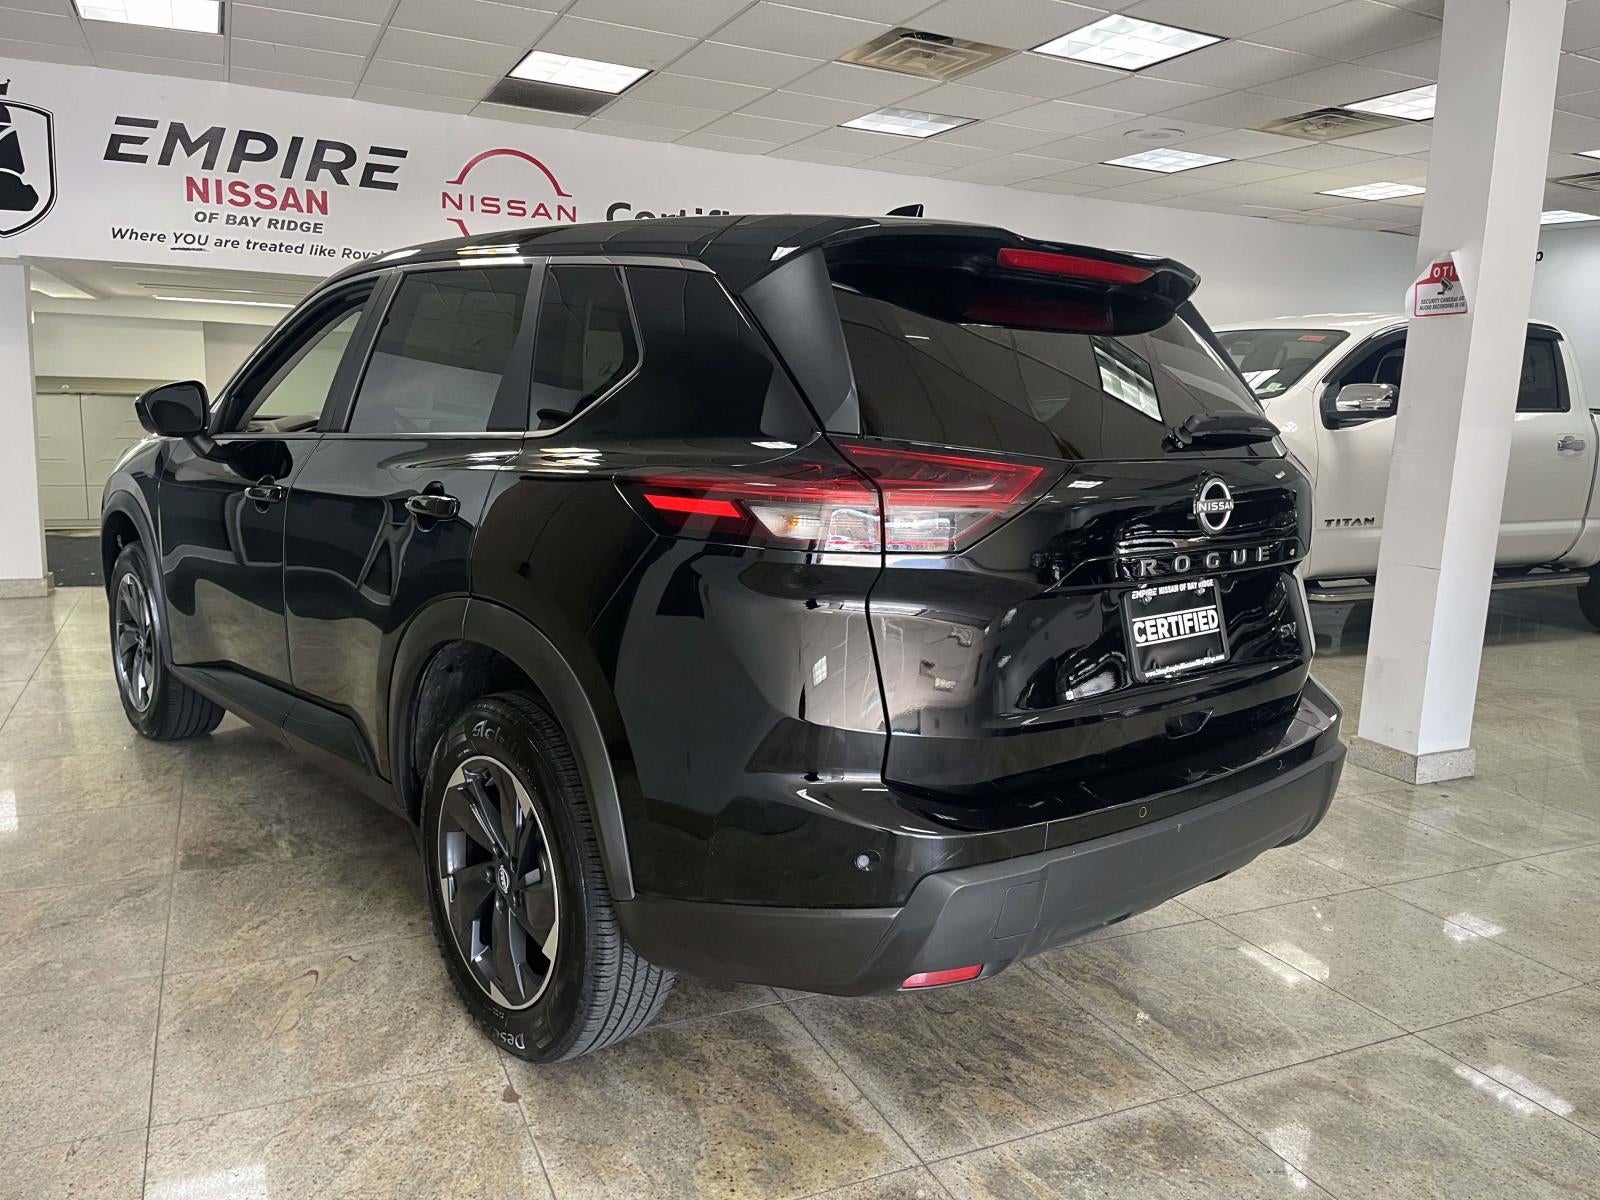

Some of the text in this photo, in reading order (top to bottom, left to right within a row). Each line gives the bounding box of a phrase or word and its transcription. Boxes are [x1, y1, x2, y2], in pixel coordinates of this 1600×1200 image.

[103, 115, 409, 191] EMPIRE
[185, 175, 329, 215] NISSAN
[441, 191, 577, 223] NISSAN
[194, 210, 325, 234] OF BAY RIDGE
[111, 227, 167, 243] Where
[173, 232, 209, 246] YOU
[214, 238, 240, 249] are
[246, 239, 305, 255] treated
[309, 244, 337, 258] like
[1198, 499, 1234, 512] NISSAN
[1324, 516, 1375, 528] TITAN
[1139, 545, 1271, 578] ROGUE
[1131, 578, 1214, 600] EMPIRE NISSAN OF BAY RIDGE
[1133, 609, 1219, 642] CERTIFIED
[1280, 621, 1297, 639] SV
